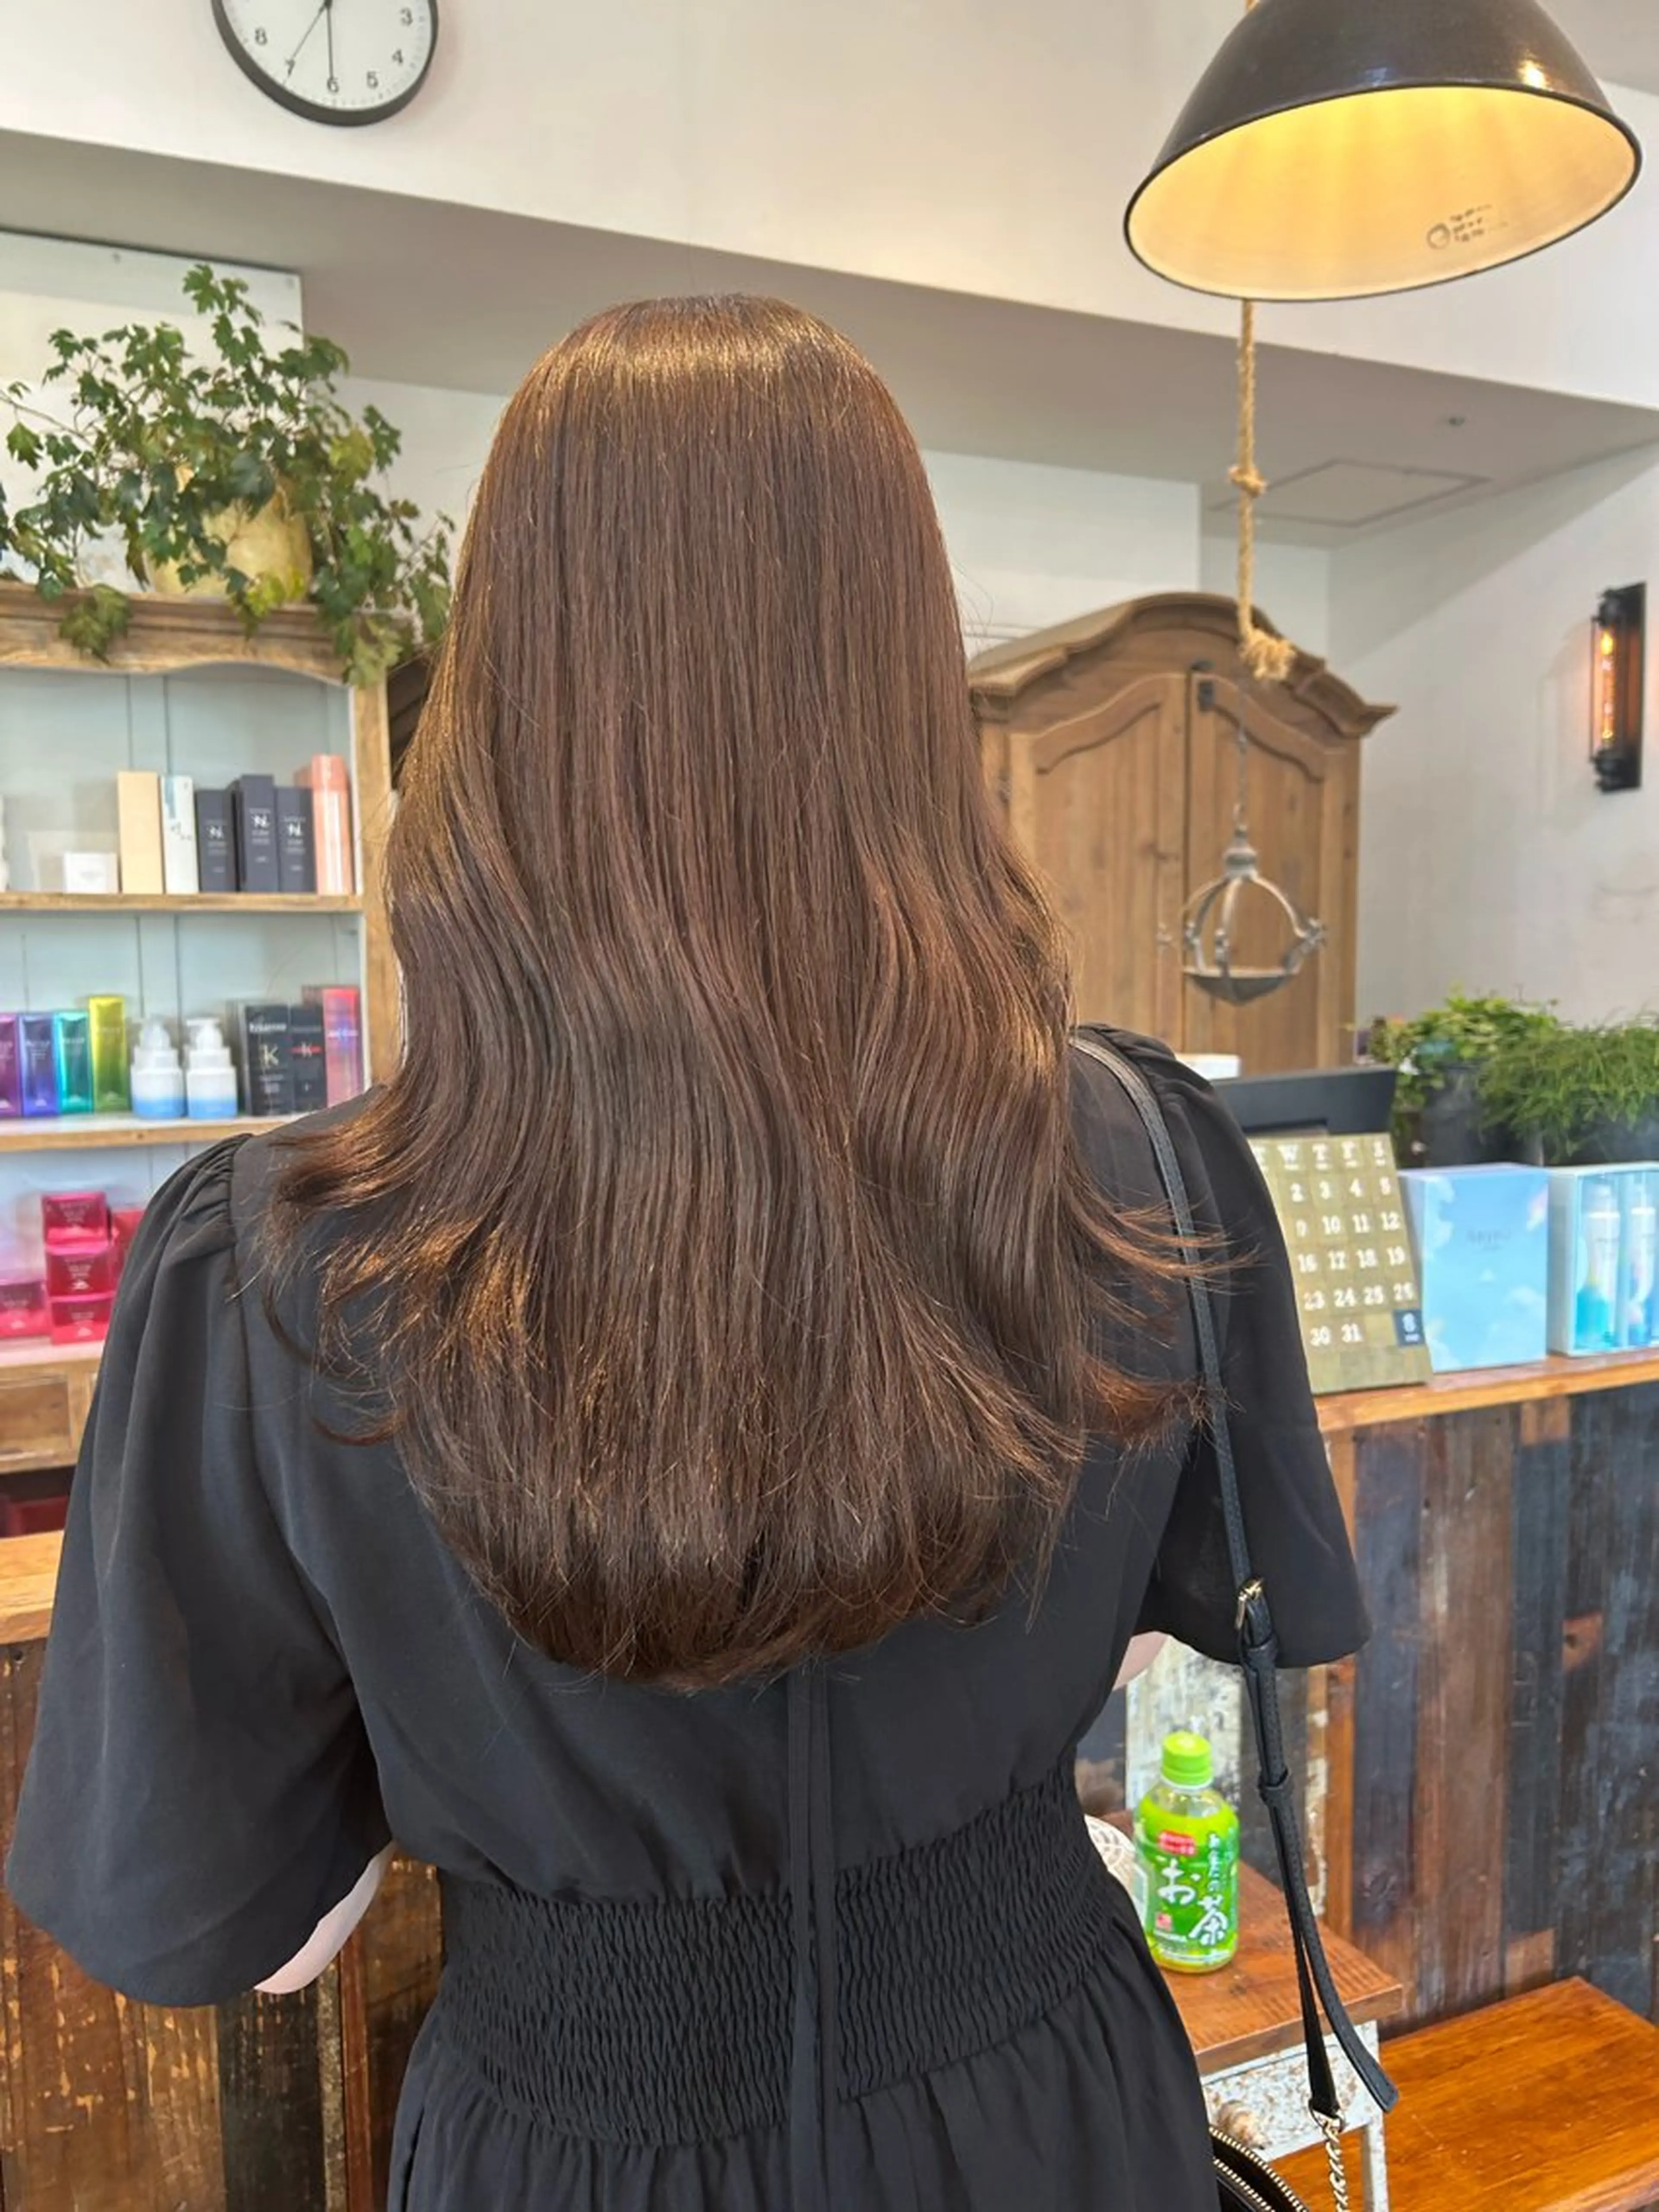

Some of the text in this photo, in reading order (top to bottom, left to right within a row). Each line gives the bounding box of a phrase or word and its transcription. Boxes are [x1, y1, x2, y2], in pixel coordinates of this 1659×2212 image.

[399, 8, 413, 26] 3
[254, 29, 268, 45] 8
[391, 49, 404, 65] 4
[285, 59, 296, 76] 7
[327, 77, 339, 94] 6
[366, 71, 378, 89] 5
[260, 1043, 279, 1068] K
[1277, 1145, 1298, 1162] W
[1312, 1143, 1327, 1160] T
[1290, 1177, 1391, 1202] 2 3 4 5
[1296, 1211, 1401, 1238] 9 10 11 12
[1298, 1246, 1405, 1273] 16 17 18 19
[1304, 1290, 1325, 1311] 23
[1333, 1287, 1356, 1308] 24
[1363, 1284, 1384, 1306] 25
[1310, 1322, 1363, 1347] 30 31
